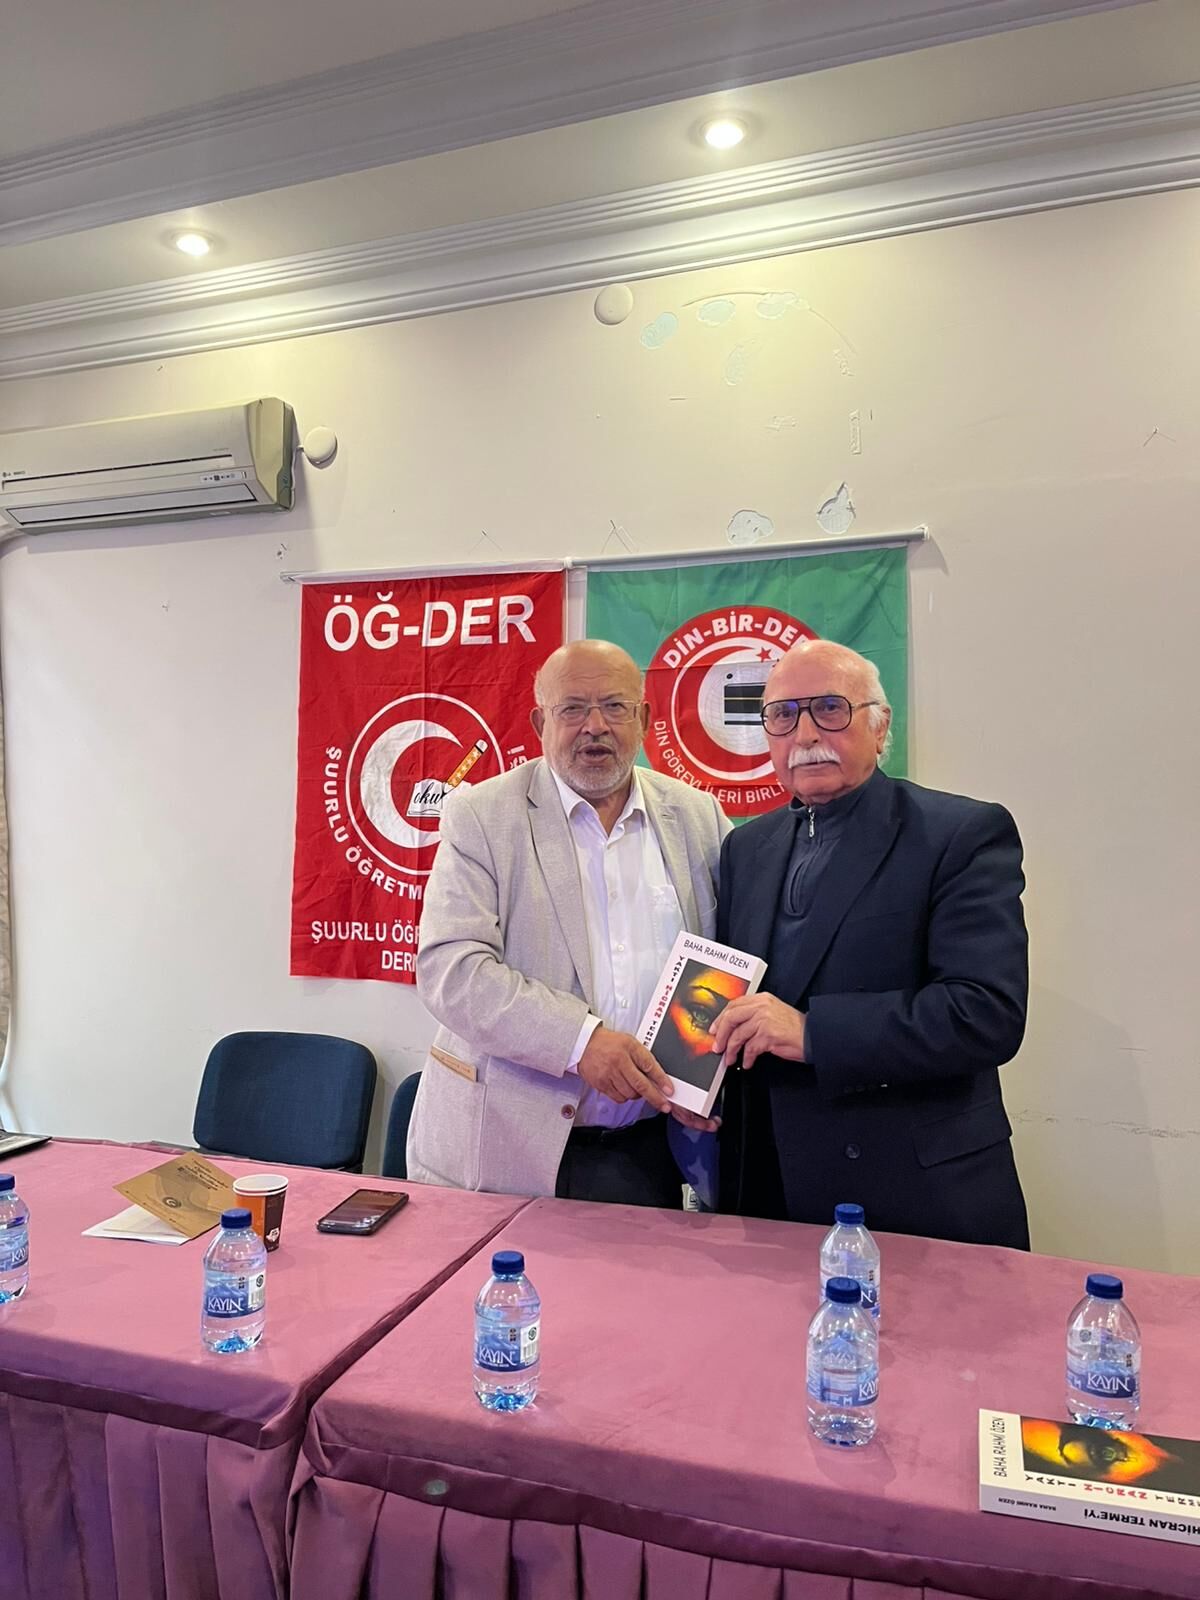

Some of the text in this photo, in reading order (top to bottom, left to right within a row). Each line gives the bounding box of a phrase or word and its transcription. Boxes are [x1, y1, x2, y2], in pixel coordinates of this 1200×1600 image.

[324, 591, 536, 652] ÖĞ-DER
[654, 720, 671, 747] DİN
[323, 746, 349, 843] ŞUURLU
[311, 920, 387, 943] ŞUURLU
[683, 939, 750, 970] BAHA RAHMİ ÖZEN
[989, 1416, 1005, 1433] ÖZEN
[993, 1456, 1008, 1478] BAHA
